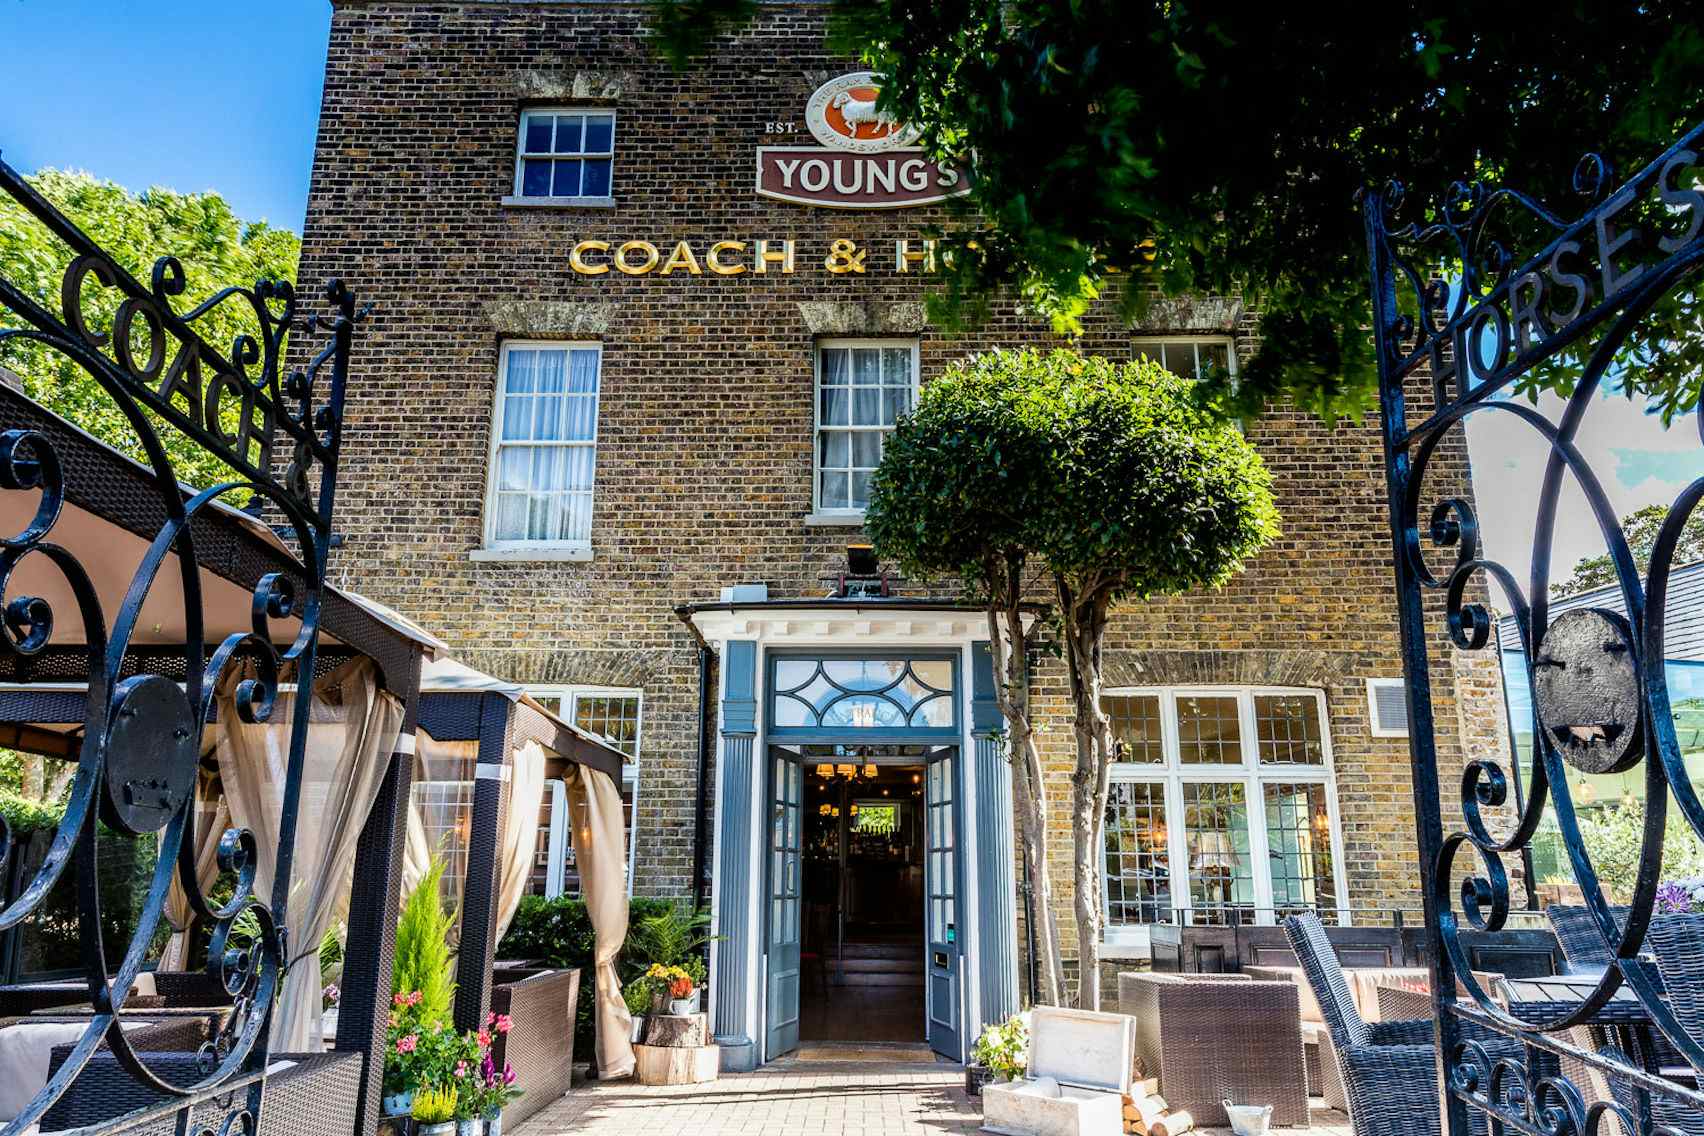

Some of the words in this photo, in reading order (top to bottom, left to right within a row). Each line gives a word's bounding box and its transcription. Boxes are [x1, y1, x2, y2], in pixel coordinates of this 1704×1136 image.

[764, 121, 799, 134] EST.
[774, 159, 960, 195] YOUNG'S
[569, 240, 795, 275] COACH
[824, 239, 867, 274] &
[1430, 149, 1704, 408] HORSES
[61, 255, 276, 480] COACH
